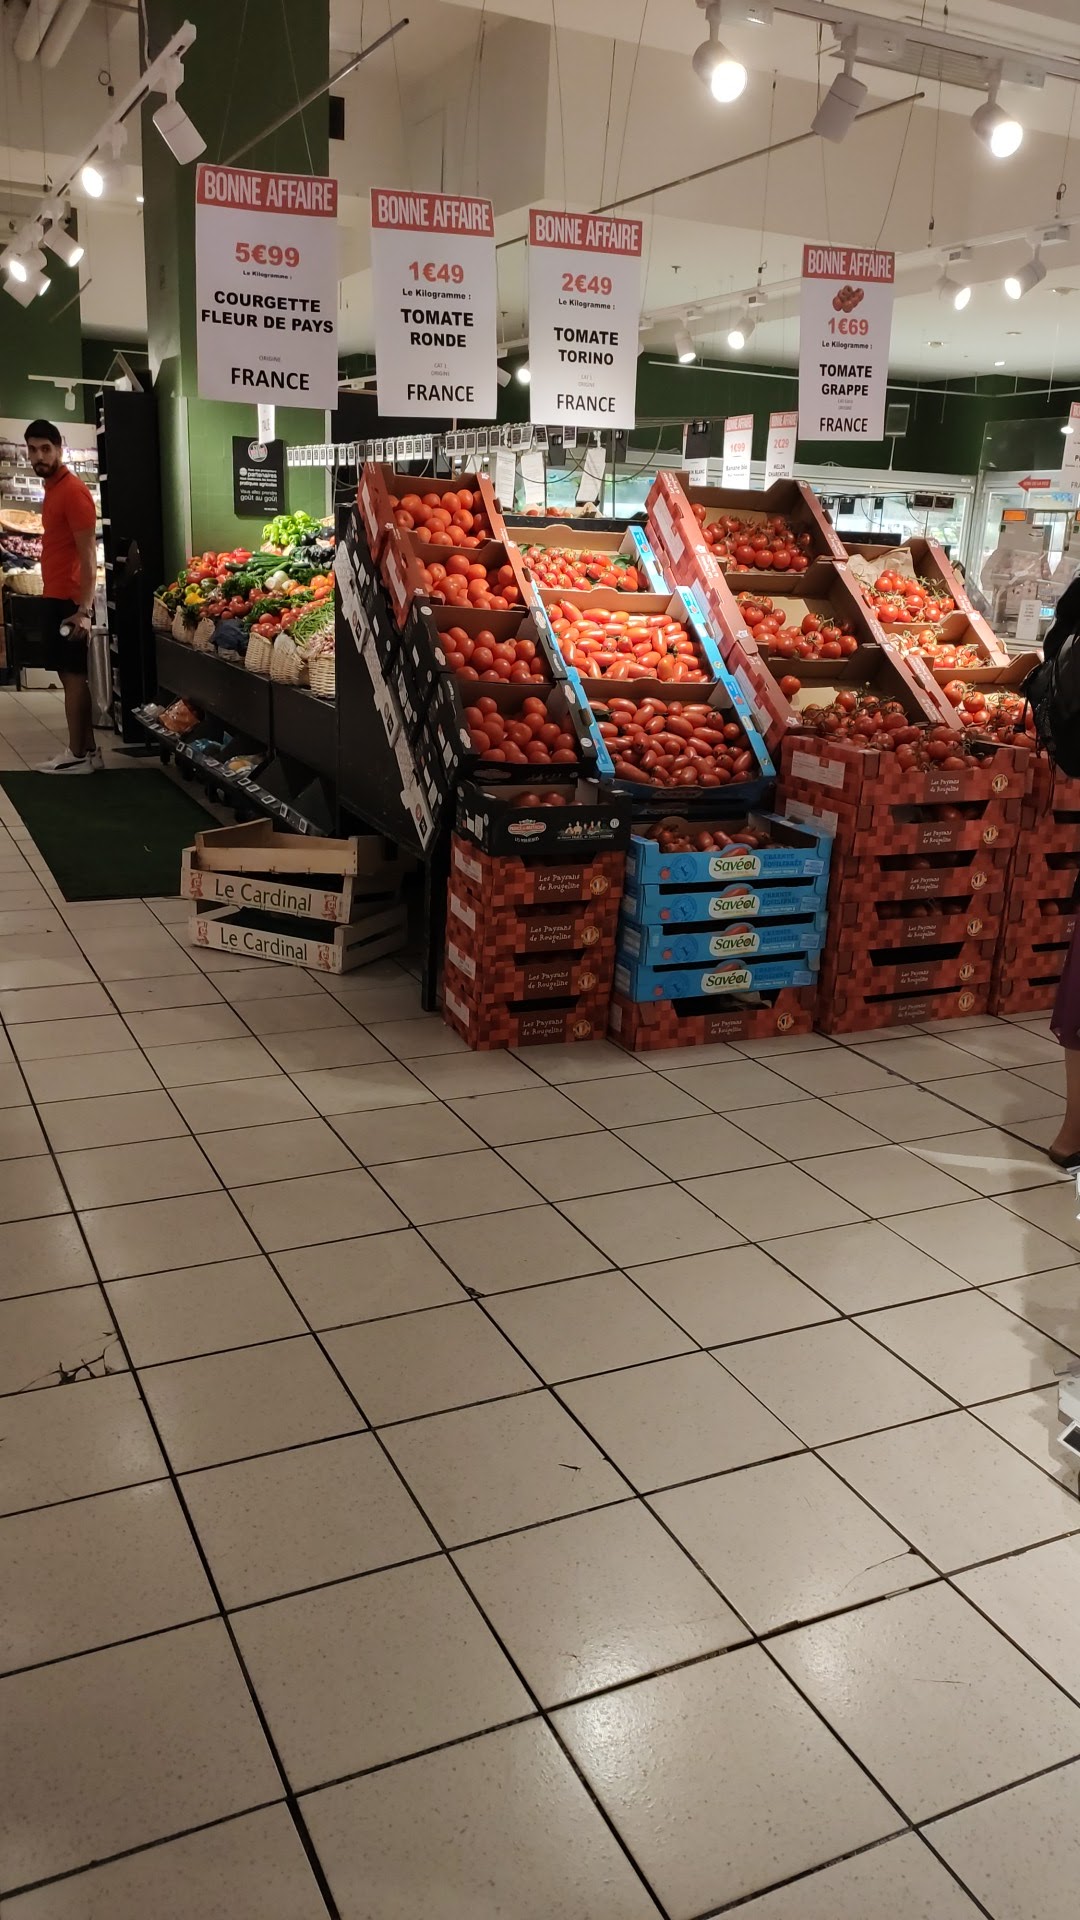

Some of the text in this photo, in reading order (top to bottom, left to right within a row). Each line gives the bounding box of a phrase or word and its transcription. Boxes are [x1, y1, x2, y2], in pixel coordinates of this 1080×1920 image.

[204, 170, 333, 211] BONNE AFFAIRE
[378, 195, 490, 231] BONNE AFFAIRE
[536, 215, 638, 250] BONNE AFFAIRE
[235, 242, 300, 268] 5€99
[808, 250, 891, 278] BONNE AFFAIRE
[409, 261, 464, 284] 1€49
[562, 273, 612, 295] 2€49
[402, 288, 413, 296] Le
[416, 289, 466, 300] Kilogramme
[214, 291, 320, 313] COURGETTE
[570, 299, 611, 310] Kilogramme
[201, 310, 333, 333] FLEUR DE PAYS
[401, 309, 474, 326] TOMATE
[828, 317, 868, 336] 1€69
[410, 332, 466, 347] RONDE
[554, 327, 618, 345] TOMATE
[558, 349, 614, 365] TORINO
[820, 364, 872, 378] TOMATE
[231, 368, 310, 390] FRANCE
[408, 384, 474, 402] FRANCE
[822, 384, 868, 396] GRAPPE
[557, 394, 616, 412] FRANCE
[820, 418, 868, 432] FRANCE
[714, 858, 756, 871] Savéol
[539, 873, 580, 884] Les Paysans
[548, 881, 580, 894] Rougeline
[216, 879, 311, 912] Le Cardinal
[713, 897, 755, 911] Savéol
[540, 932, 571, 943] Rougeline
[544, 924, 571, 936] Paysans
[221, 927, 307, 961] Le Cardinal
[714, 935, 755, 950] Savéol
[538, 979, 568, 990] Rougeline
[542, 971, 568, 983] Paysans
[706, 972, 748, 986] Savéol
[523, 1018, 563, 1030] Les Paysans
[522, 1027, 563, 1038] de Rougeline
